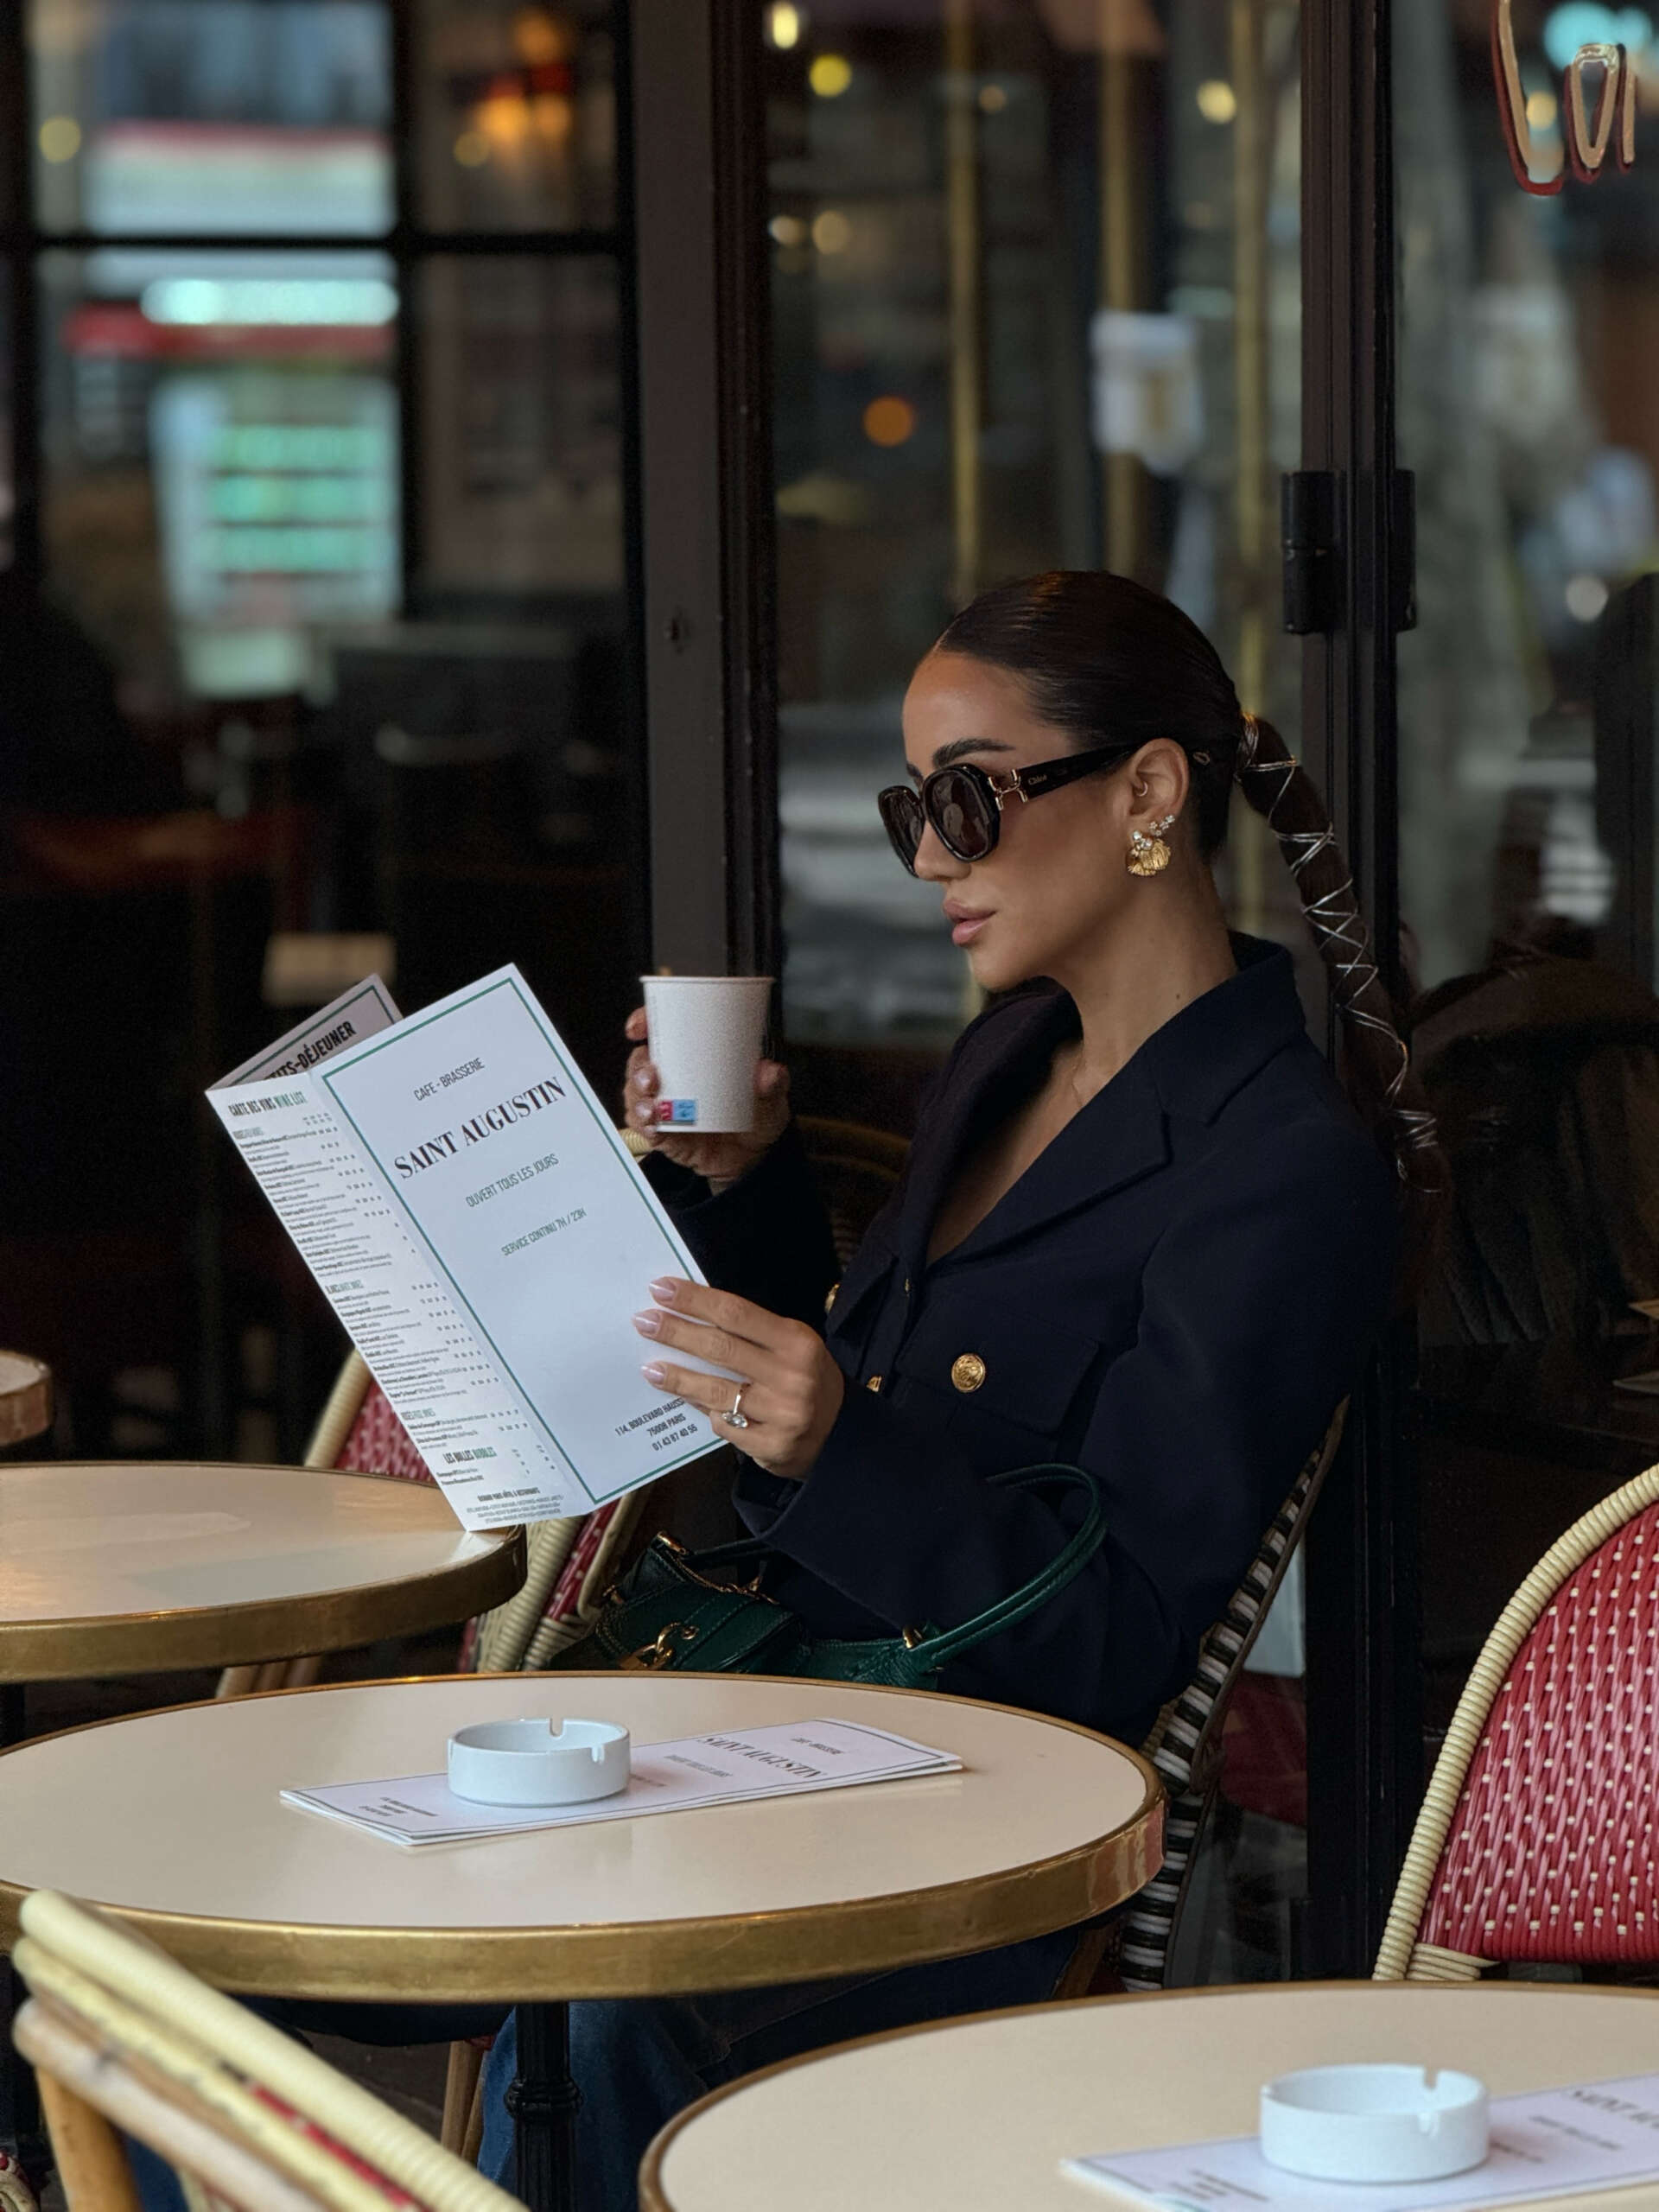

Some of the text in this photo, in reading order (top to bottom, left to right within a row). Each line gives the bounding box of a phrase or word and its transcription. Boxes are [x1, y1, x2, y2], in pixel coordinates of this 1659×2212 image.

[439, 1057, 486, 1088] BRASSERIE
[394, 1130, 459, 1179] SAINT
[461, 1077, 567, 1147] AUGUSTIN
[465, 1153, 559, 1207] OUVERT TOUS LES JOURS
[501, 1235, 530, 1256] SERVICE
[527, 1221, 557, 1243] CONTINU
[628, 1407, 664, 1429] BOULEVARD
[666, 1413, 686, 1427] PARIS
